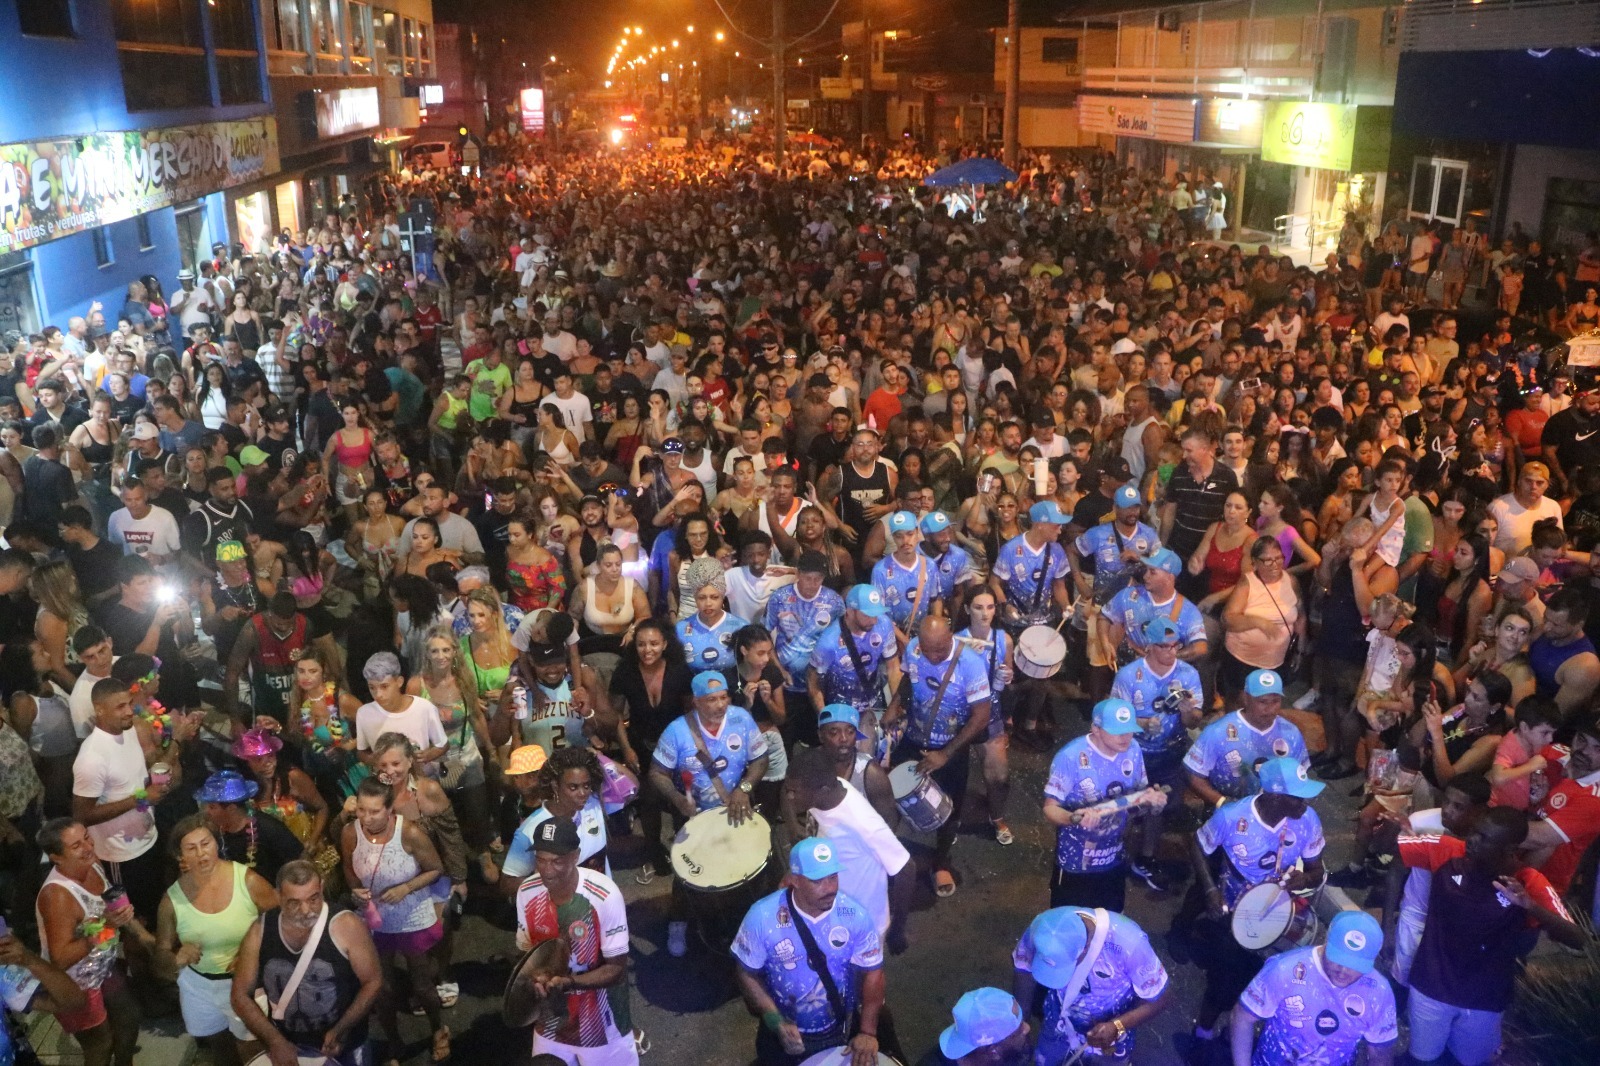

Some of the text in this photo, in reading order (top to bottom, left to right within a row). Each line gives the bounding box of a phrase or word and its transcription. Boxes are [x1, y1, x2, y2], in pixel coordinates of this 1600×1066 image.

[1117, 115, 1148, 131] São João
[31, 158, 51, 213] E
[130, 135, 223, 196] MERCADO
[14, 222, 46, 245] frutas
[47, 222, 55, 234] e
[56, 209, 97, 231] verduras
[531, 701, 557, 722] BUZZ
[551, 724, 566, 749] 2
